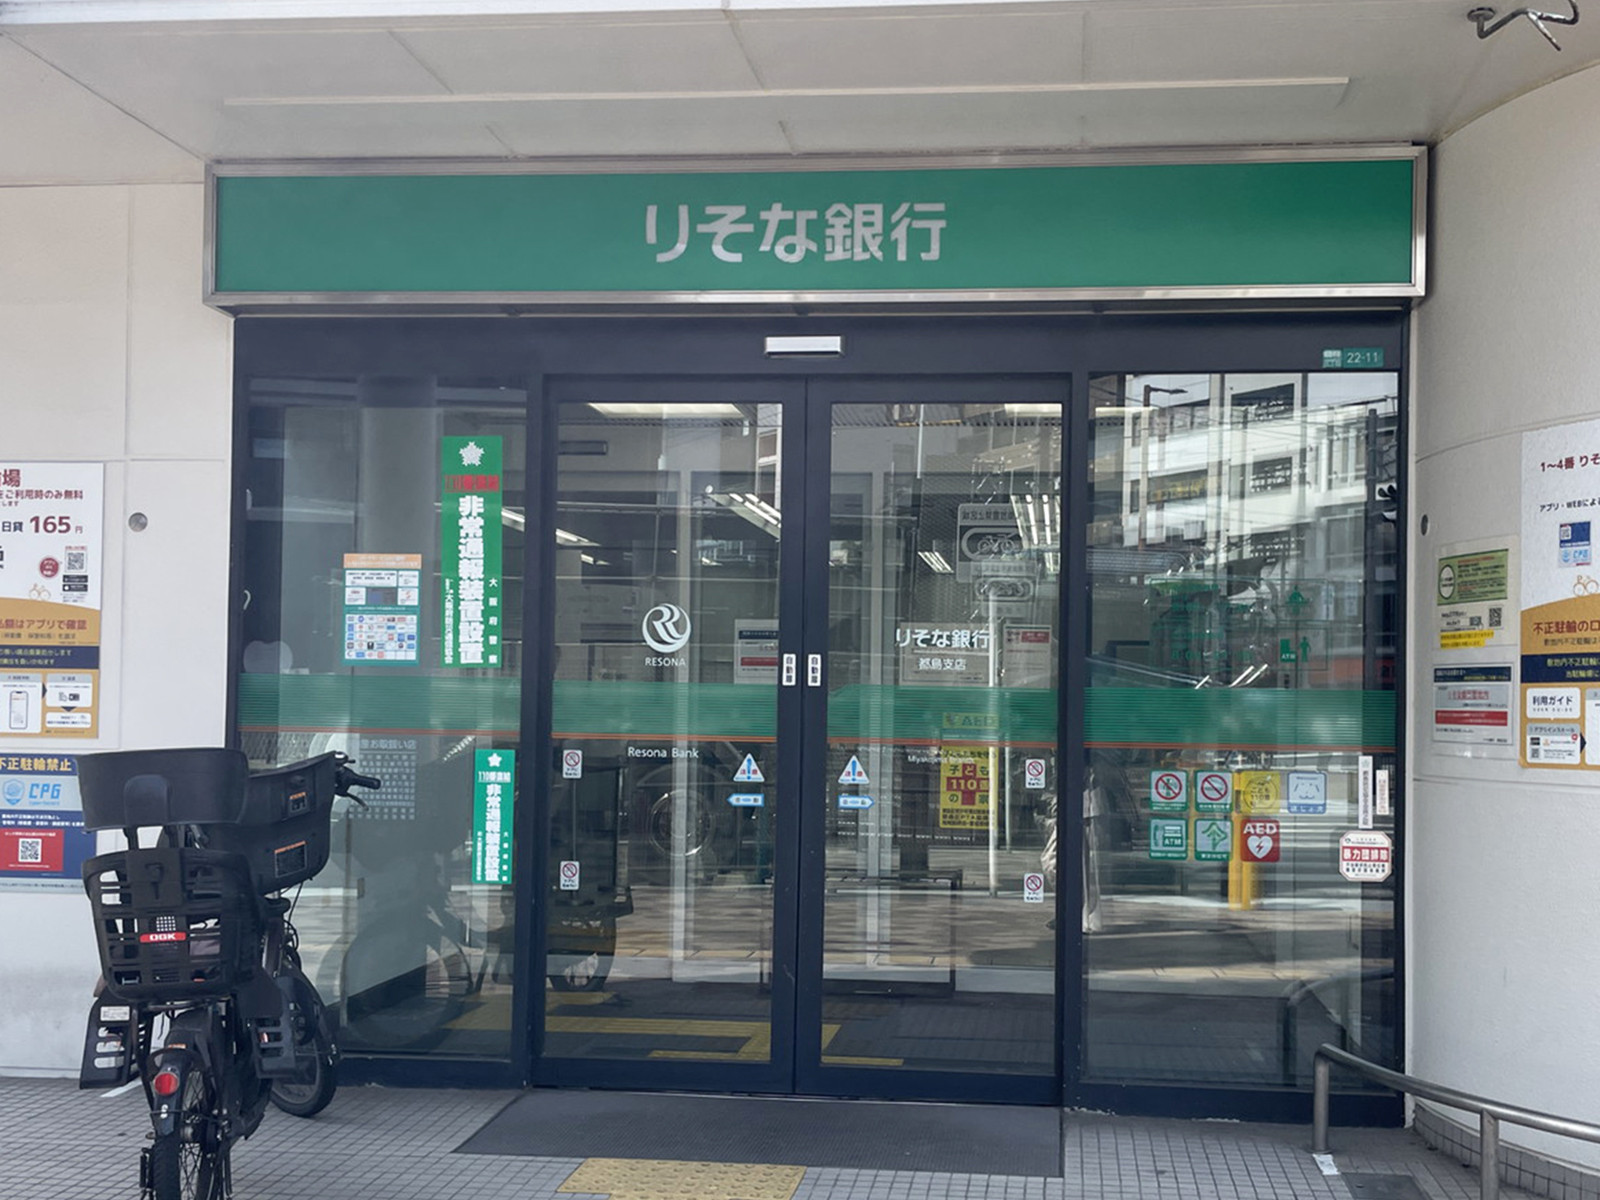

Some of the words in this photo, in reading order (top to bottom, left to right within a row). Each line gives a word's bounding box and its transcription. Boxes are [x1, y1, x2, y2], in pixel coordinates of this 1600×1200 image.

[646, 202, 947, 263] りそな銀行
[1540, 498, 1600, 512] アプリ・WEBによ
[30, 516, 72, 534] 165
[896, 628, 991, 649] りそな銀行
[645, 657, 686, 667] RESONA
[628, 747, 667, 758] Resona
[672, 747, 699, 759] Bank
[1243, 823, 1278, 834] AED
[1164, 838, 1182, 846] ATM
[149, 933, 176, 941] OGK
